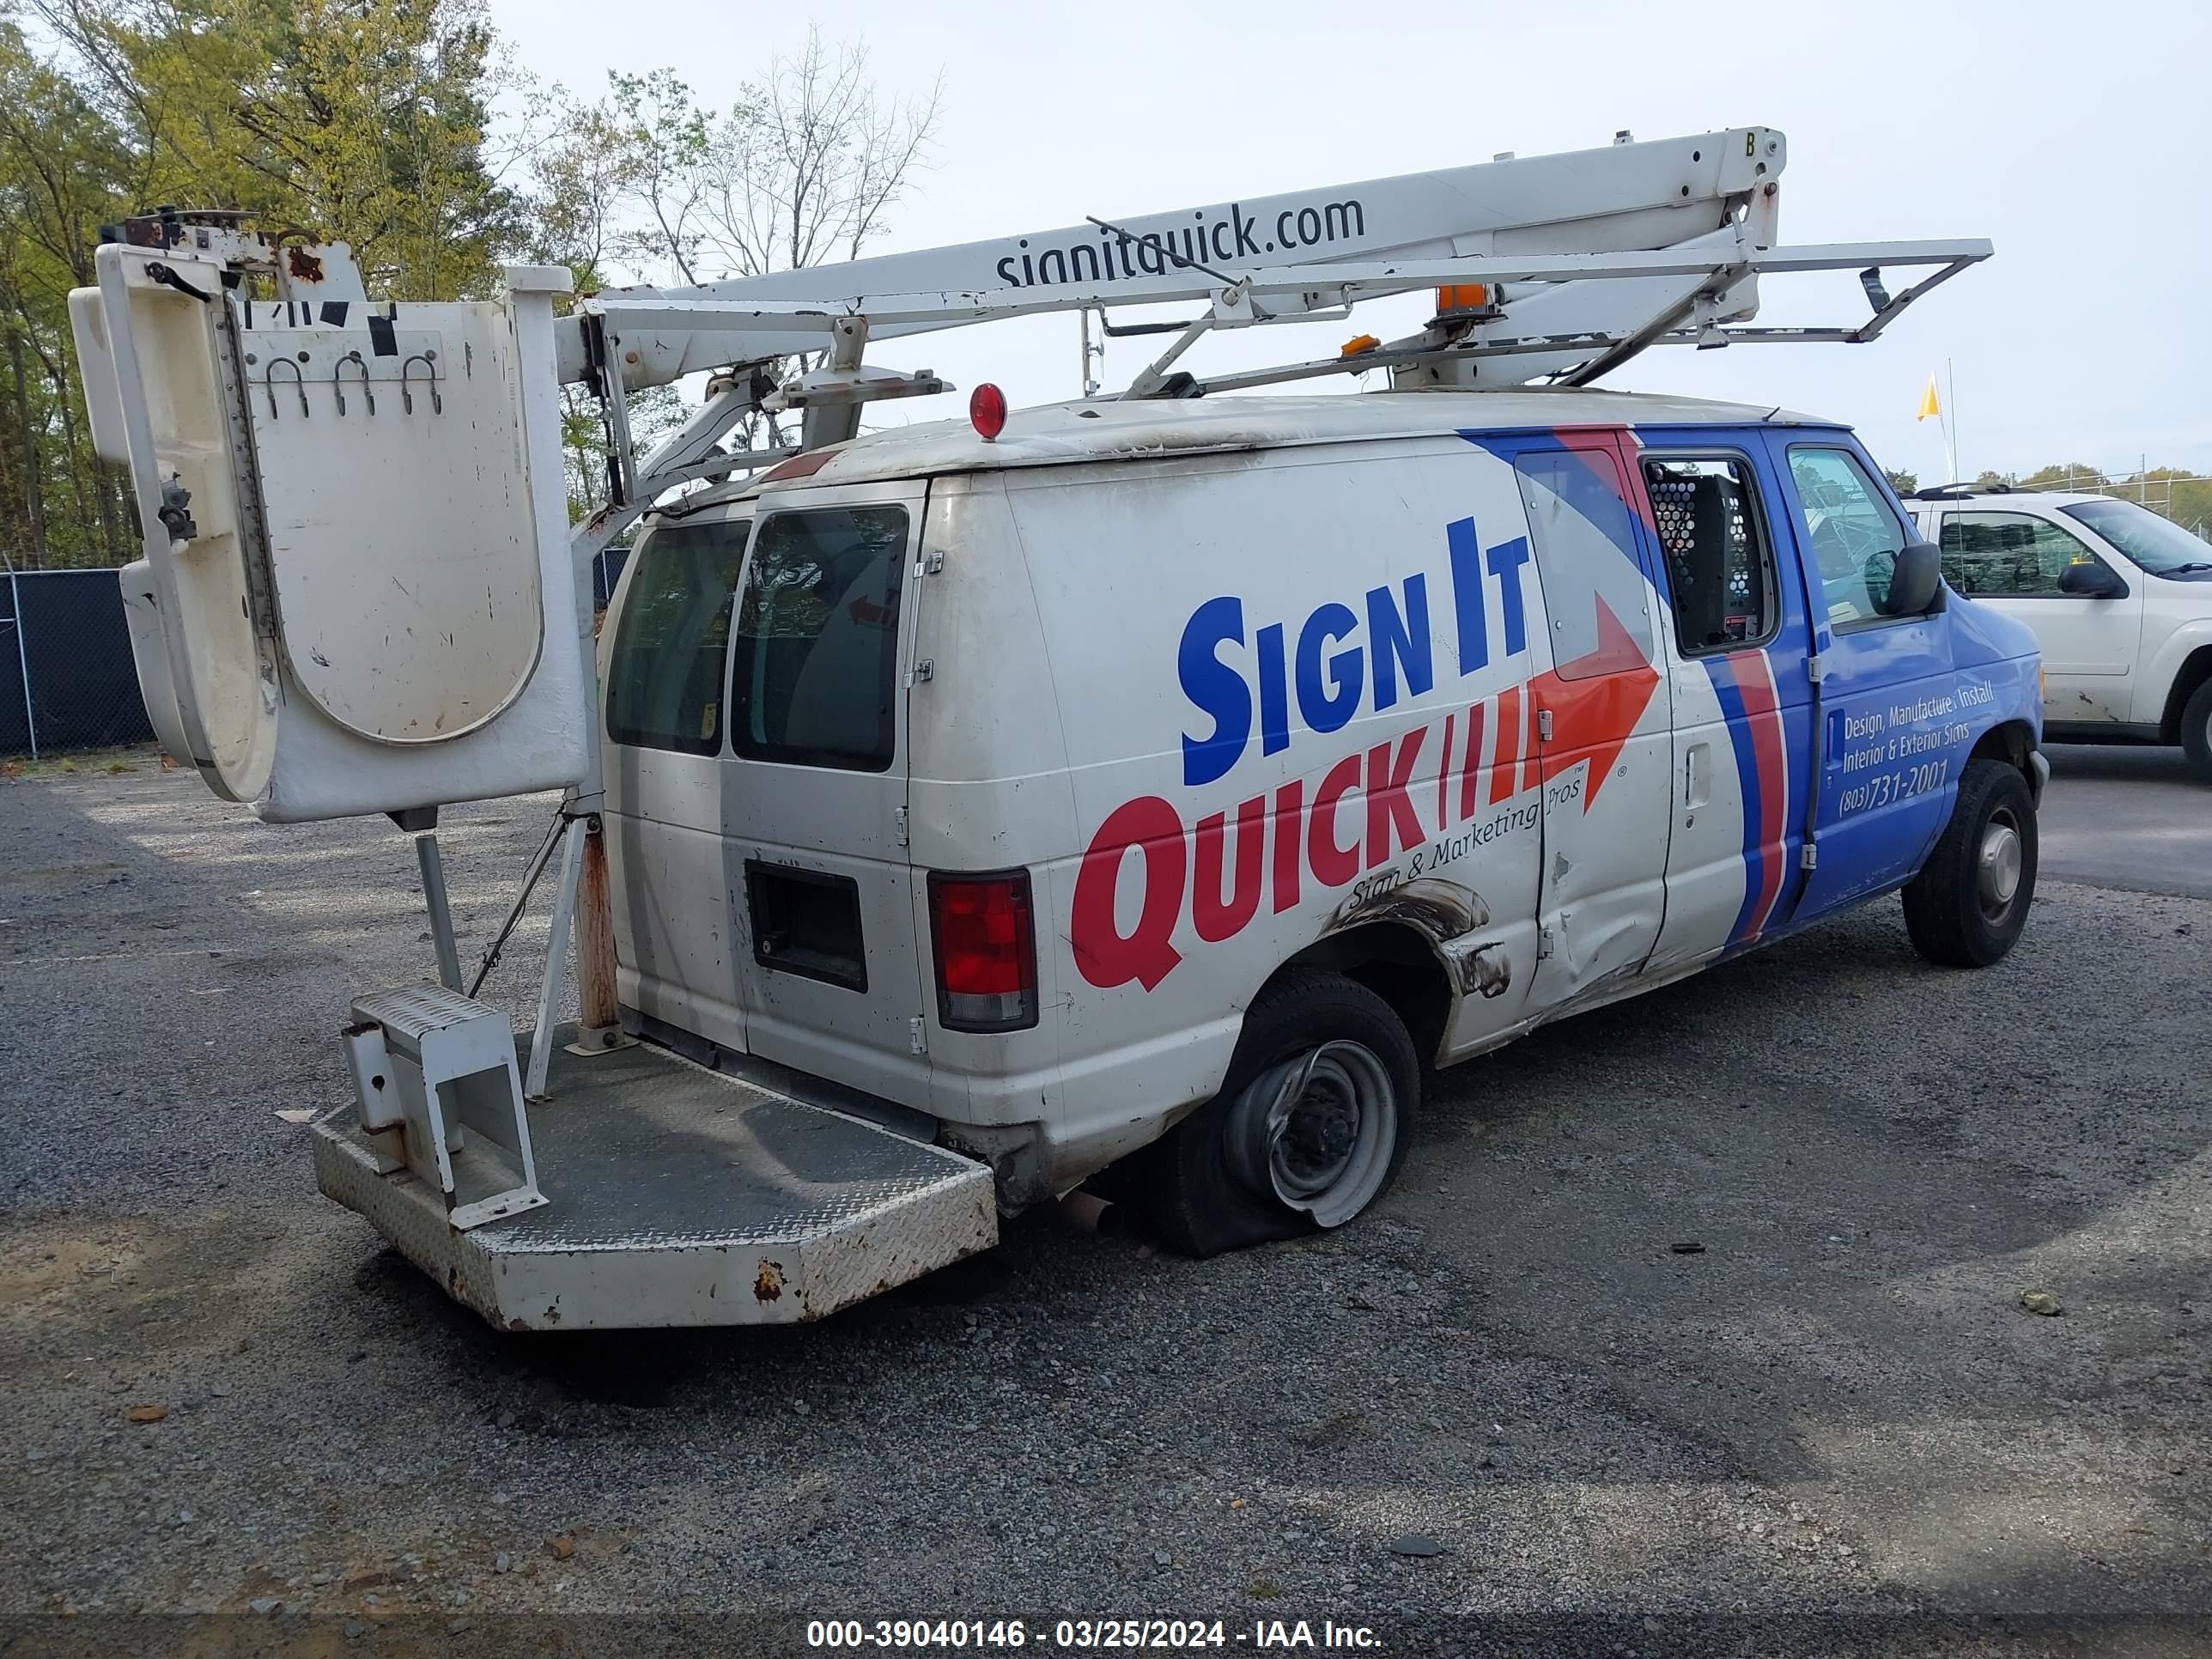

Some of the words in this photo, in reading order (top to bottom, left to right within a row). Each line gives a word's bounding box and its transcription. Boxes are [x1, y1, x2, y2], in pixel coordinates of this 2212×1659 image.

[1746, 131, 1755, 157] B
[1177, 572, 1434, 787] SIGN
[1844, 711, 1887, 740] Design,
[1957, 679, 1994, 708] Install
[1843, 743, 1886, 774] Interior
[1888, 738, 1897, 761] &
[1899, 727, 1942, 757] Exterior
[1071, 725, 1428, 994] QUICK
[1407, 852, 1425, 880] &
[1428, 802, 1540, 871] Marketing
[1546, 778, 1581, 816] Pros
